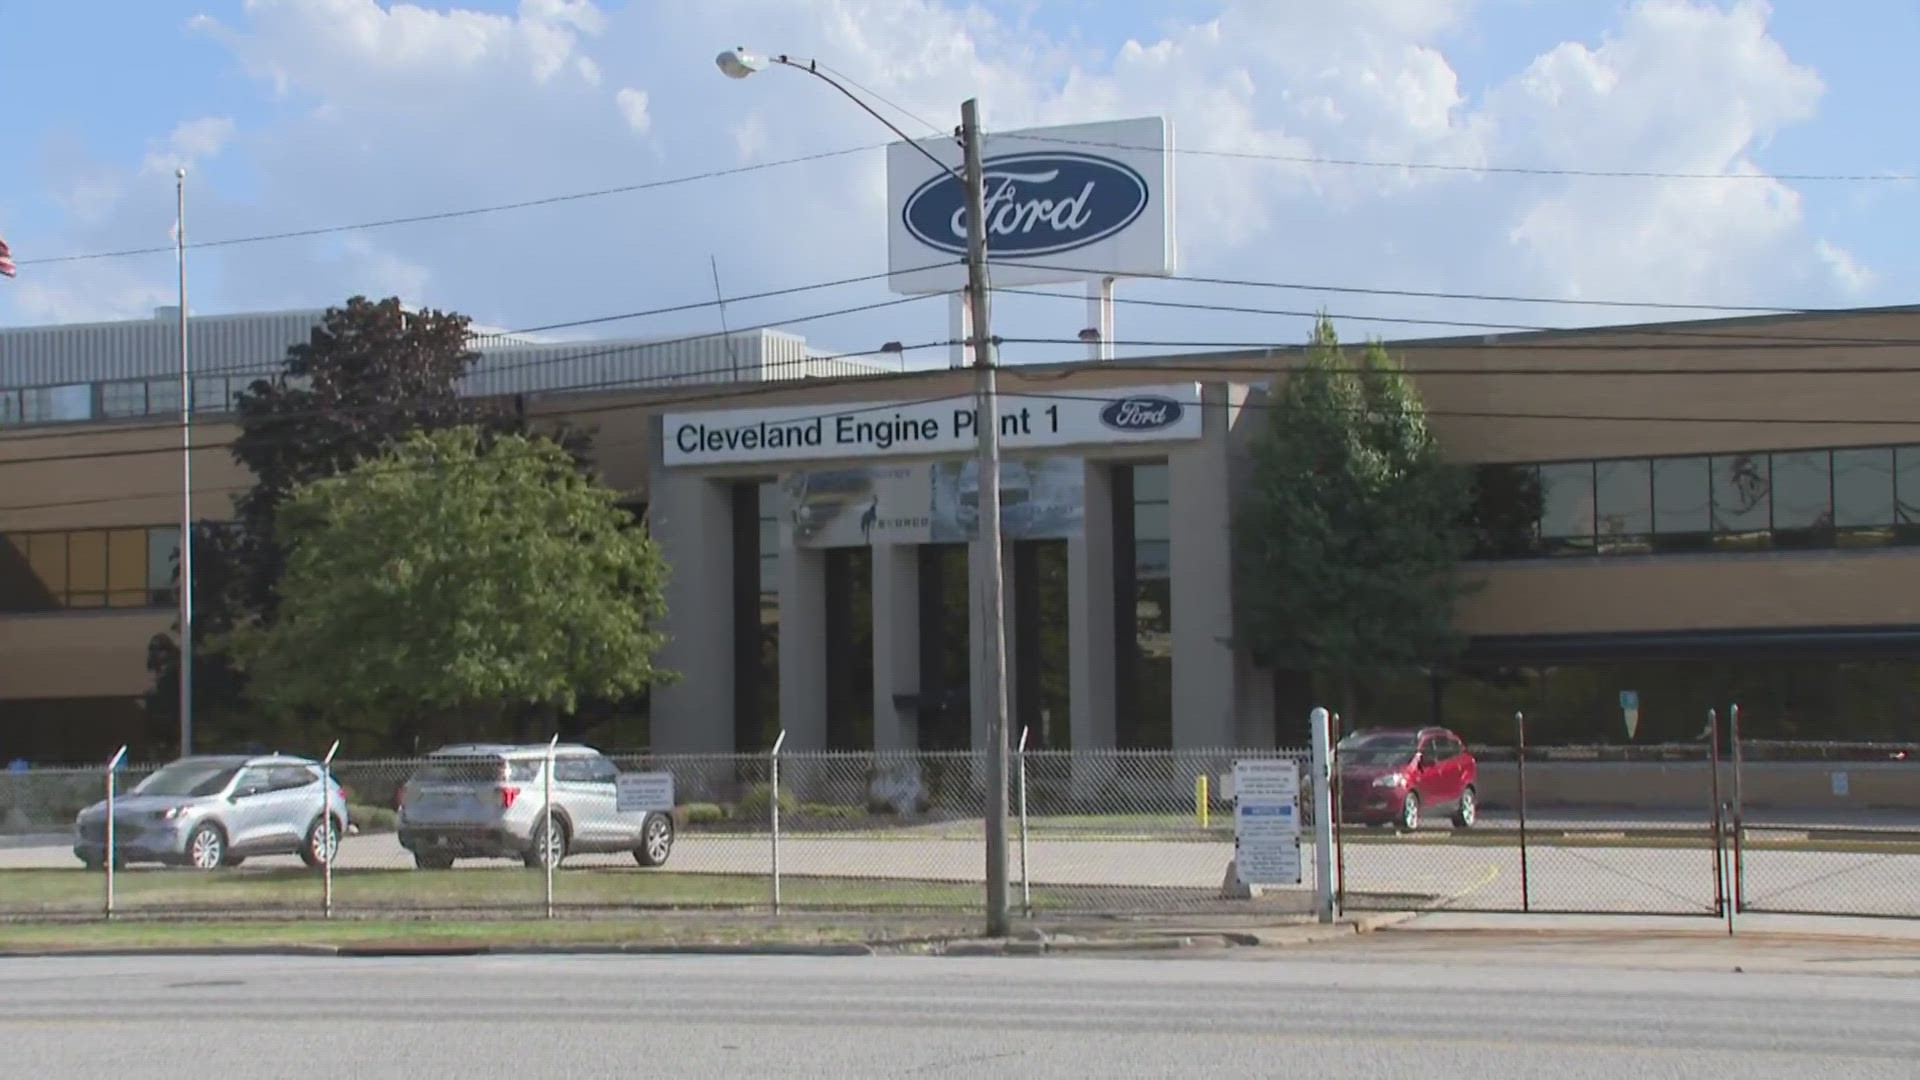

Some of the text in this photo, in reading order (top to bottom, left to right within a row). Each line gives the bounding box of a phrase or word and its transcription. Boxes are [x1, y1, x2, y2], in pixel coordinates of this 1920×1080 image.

[951, 169, 1095, 238] Ford
[677, 404, 1058, 453] Cleveland Engine Plnt 1
[1116, 401, 1167, 426] Ford
